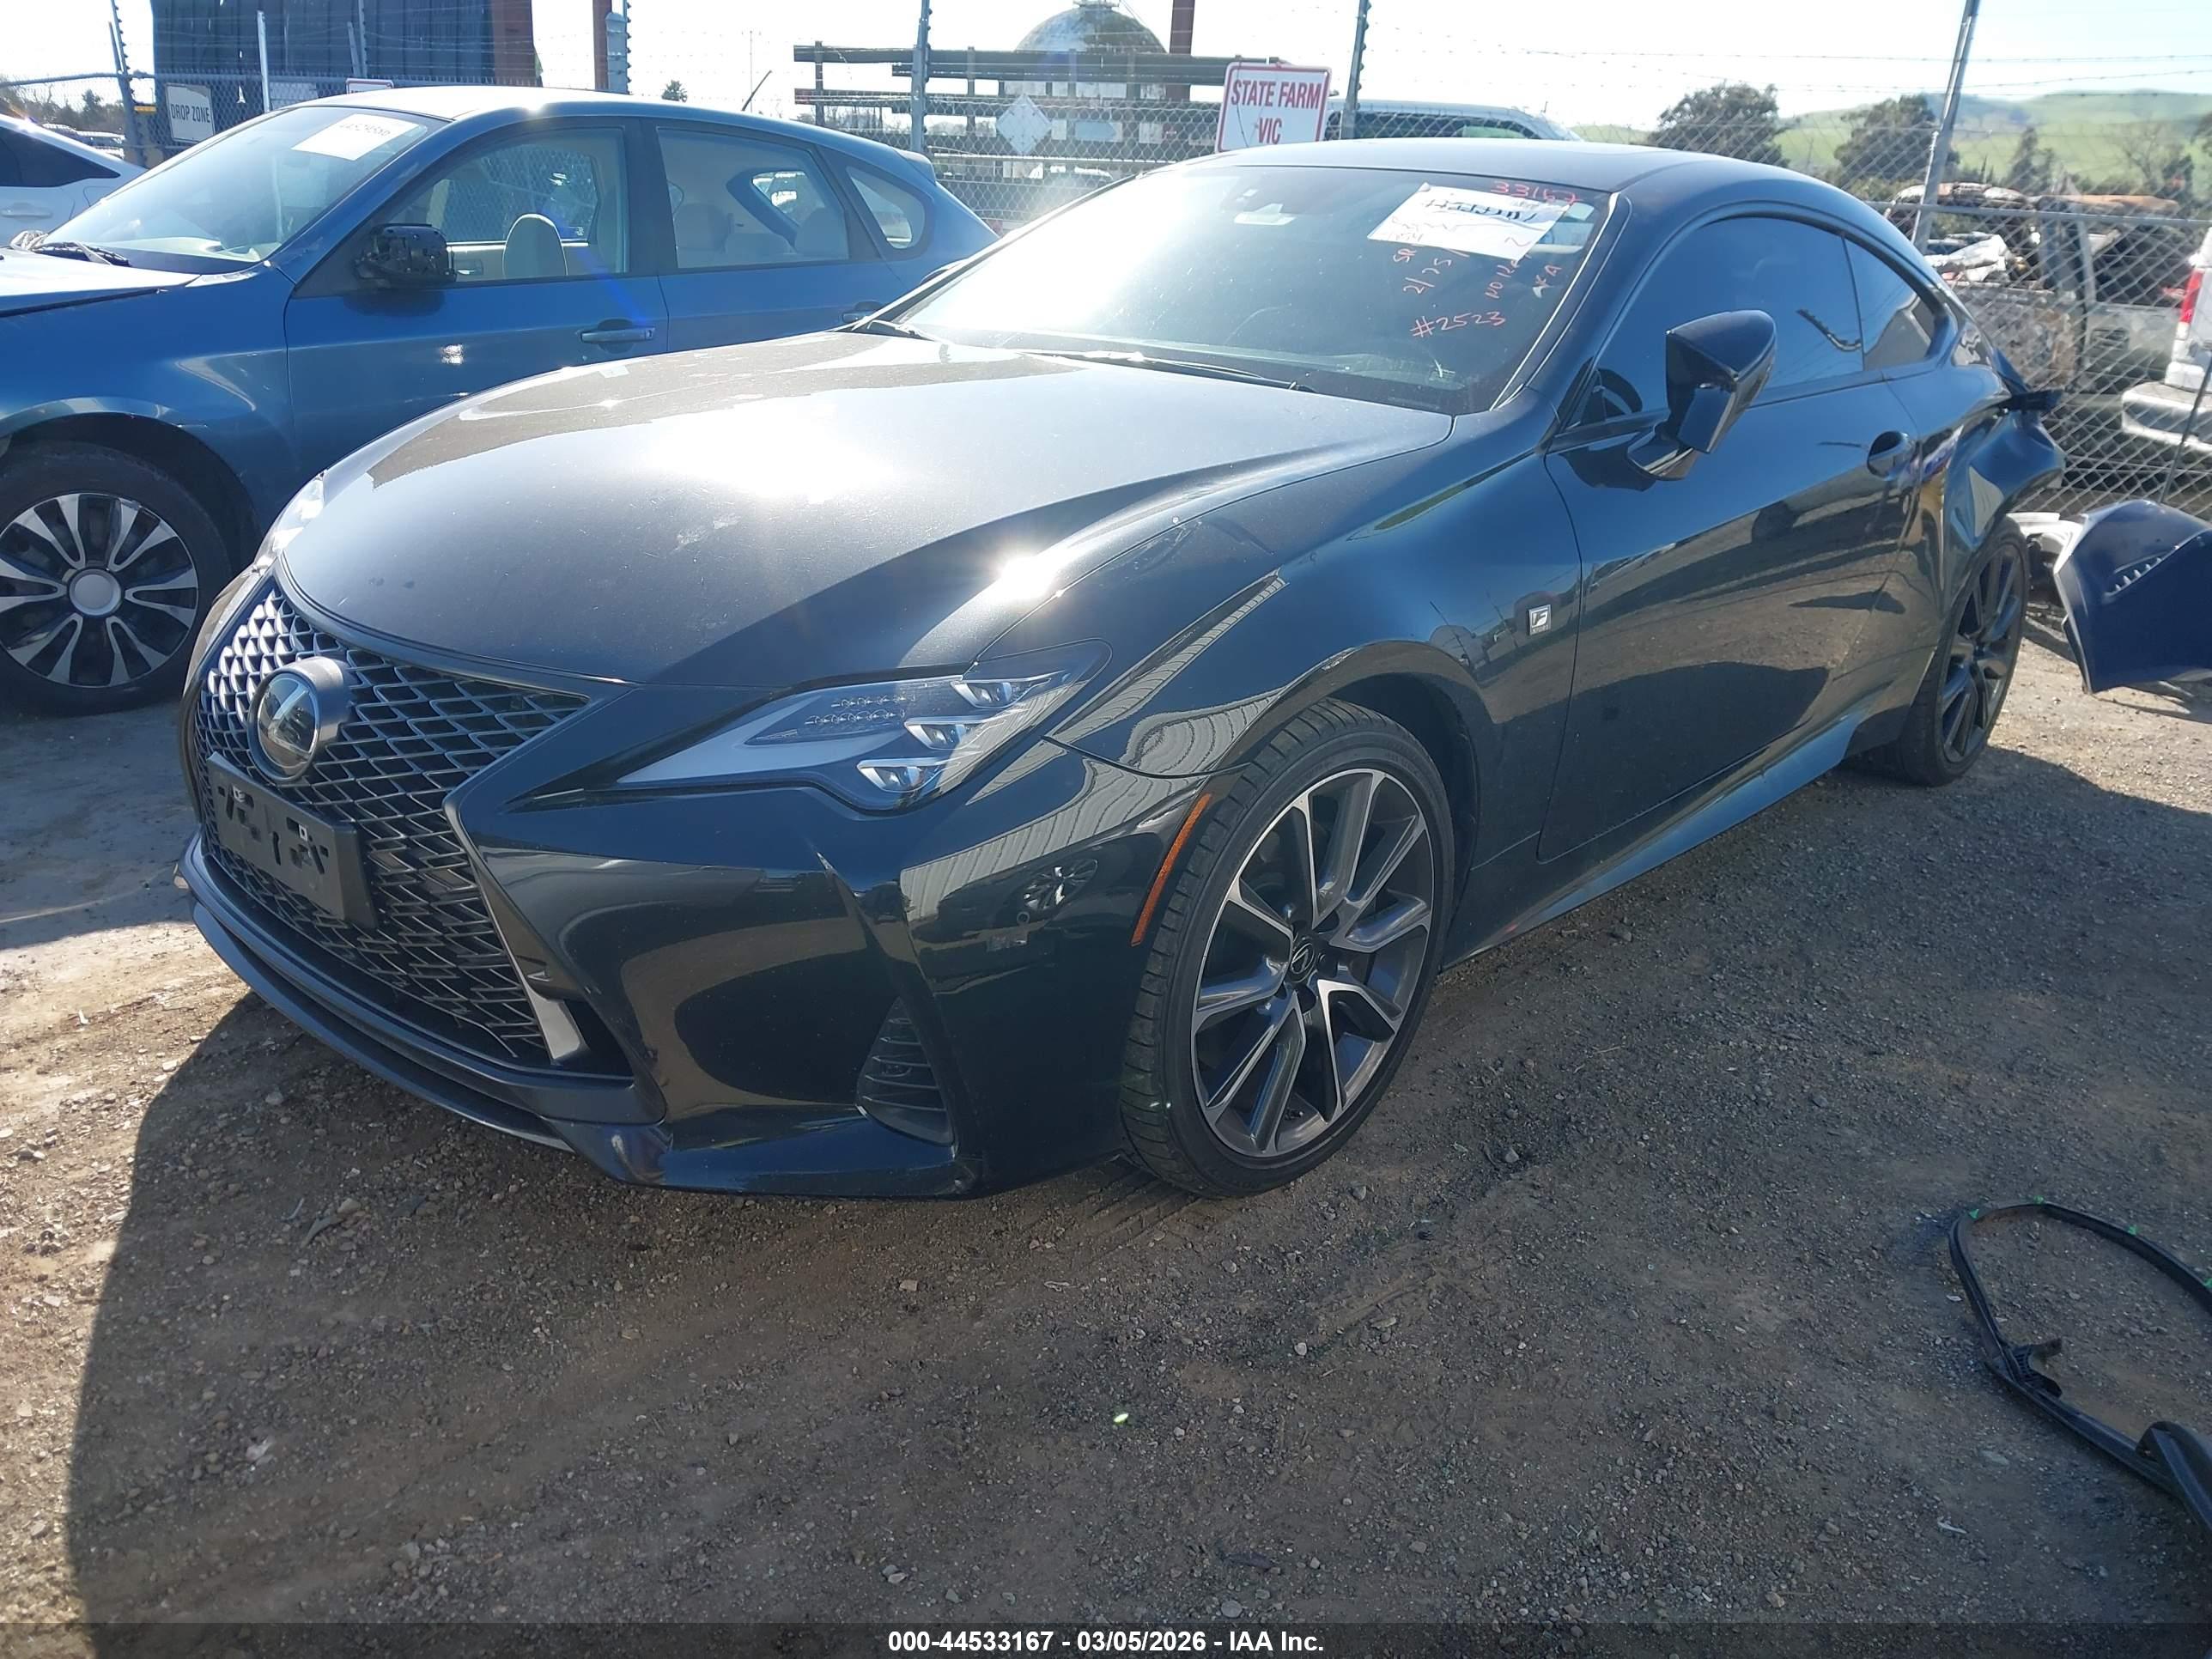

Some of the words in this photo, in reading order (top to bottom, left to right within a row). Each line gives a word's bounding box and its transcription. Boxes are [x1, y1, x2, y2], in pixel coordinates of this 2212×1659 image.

[1231, 79, 1276, 107] STATE
[1278, 81, 1322, 110] FARM
[170, 103, 191, 120] DROP
[191, 105, 211, 124] ZONE
[1258, 117, 1283, 145] VIC
[1409, 310, 1507, 337] #2523
